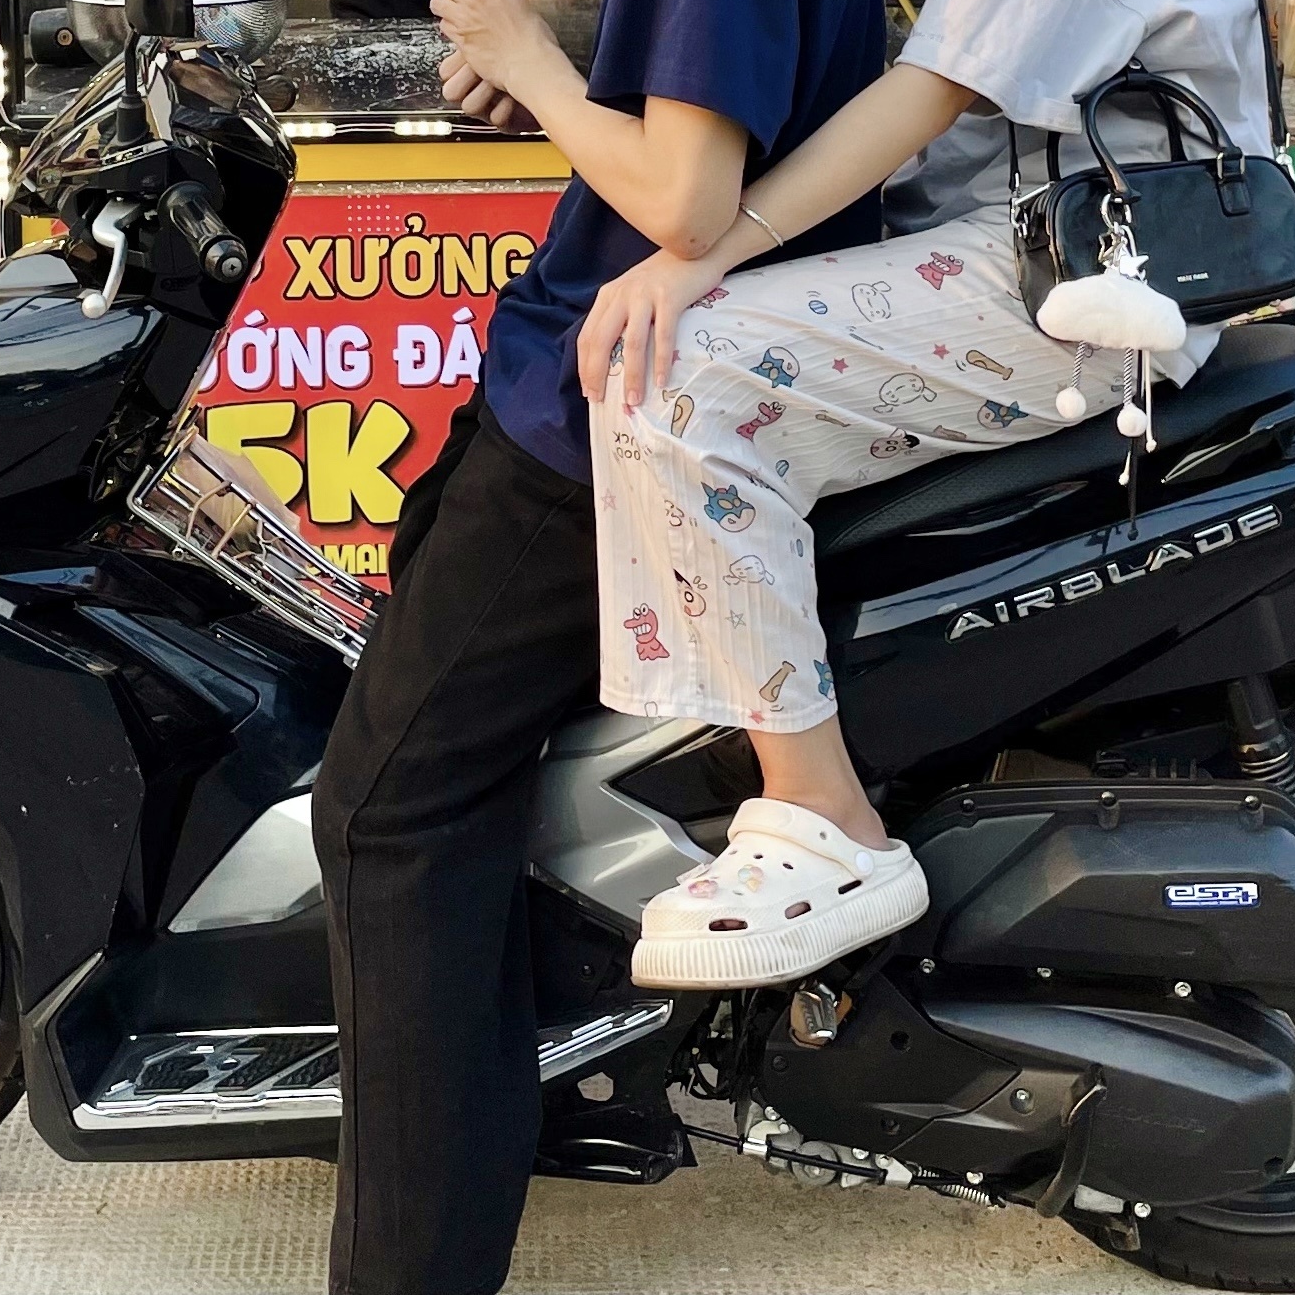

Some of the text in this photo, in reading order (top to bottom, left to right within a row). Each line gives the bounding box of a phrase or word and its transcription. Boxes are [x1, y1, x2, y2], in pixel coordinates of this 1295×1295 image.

[285, 214, 537, 298] XƯỞNG
[199, 306, 482, 390] ỚNG ĐÁ
[205, 400, 411, 524] 5K
[948, 504, 1280, 641] AIRBLADE
